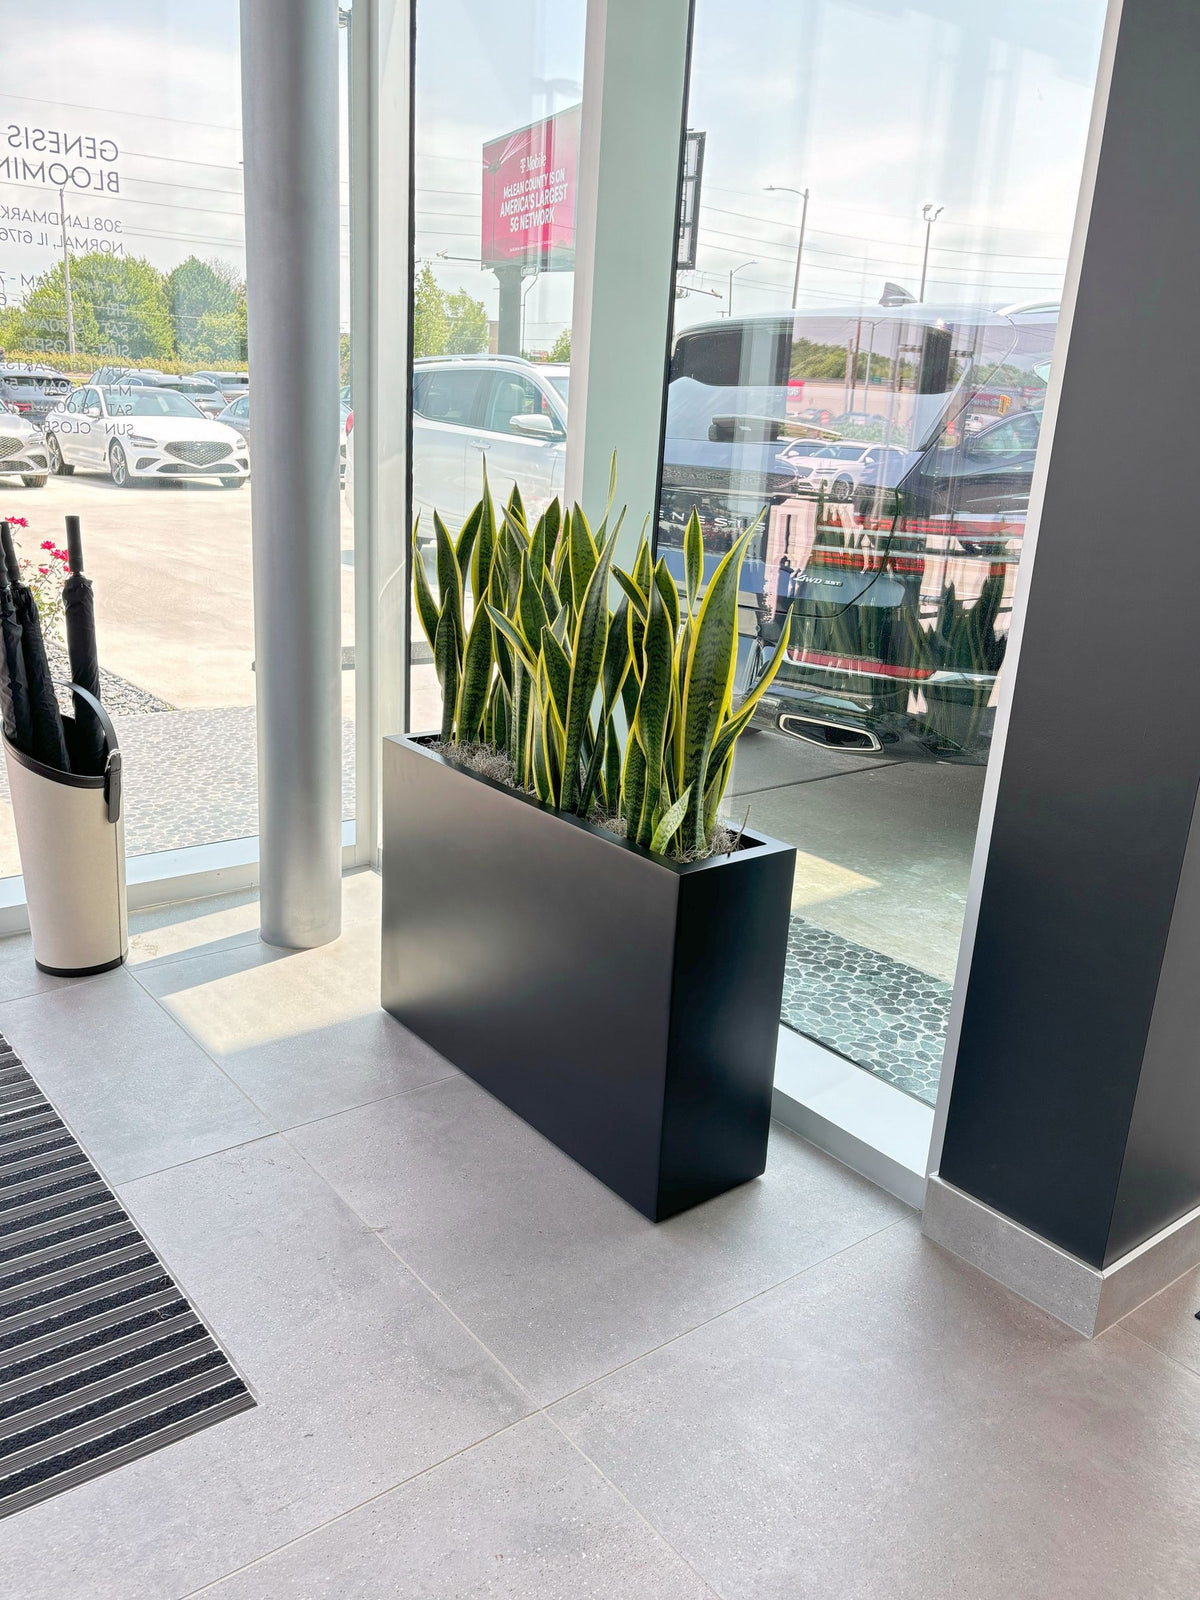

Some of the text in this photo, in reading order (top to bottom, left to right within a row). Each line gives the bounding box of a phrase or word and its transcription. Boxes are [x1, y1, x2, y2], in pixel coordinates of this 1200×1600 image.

[525, 173, 549, 192] COUNTY
[549, 171, 556, 185] IS
[556, 168, 566, 183] ON
[500, 183, 568, 217] AMERICA'S LARGEST
[510, 206, 555, 233] 5G NETWORK
